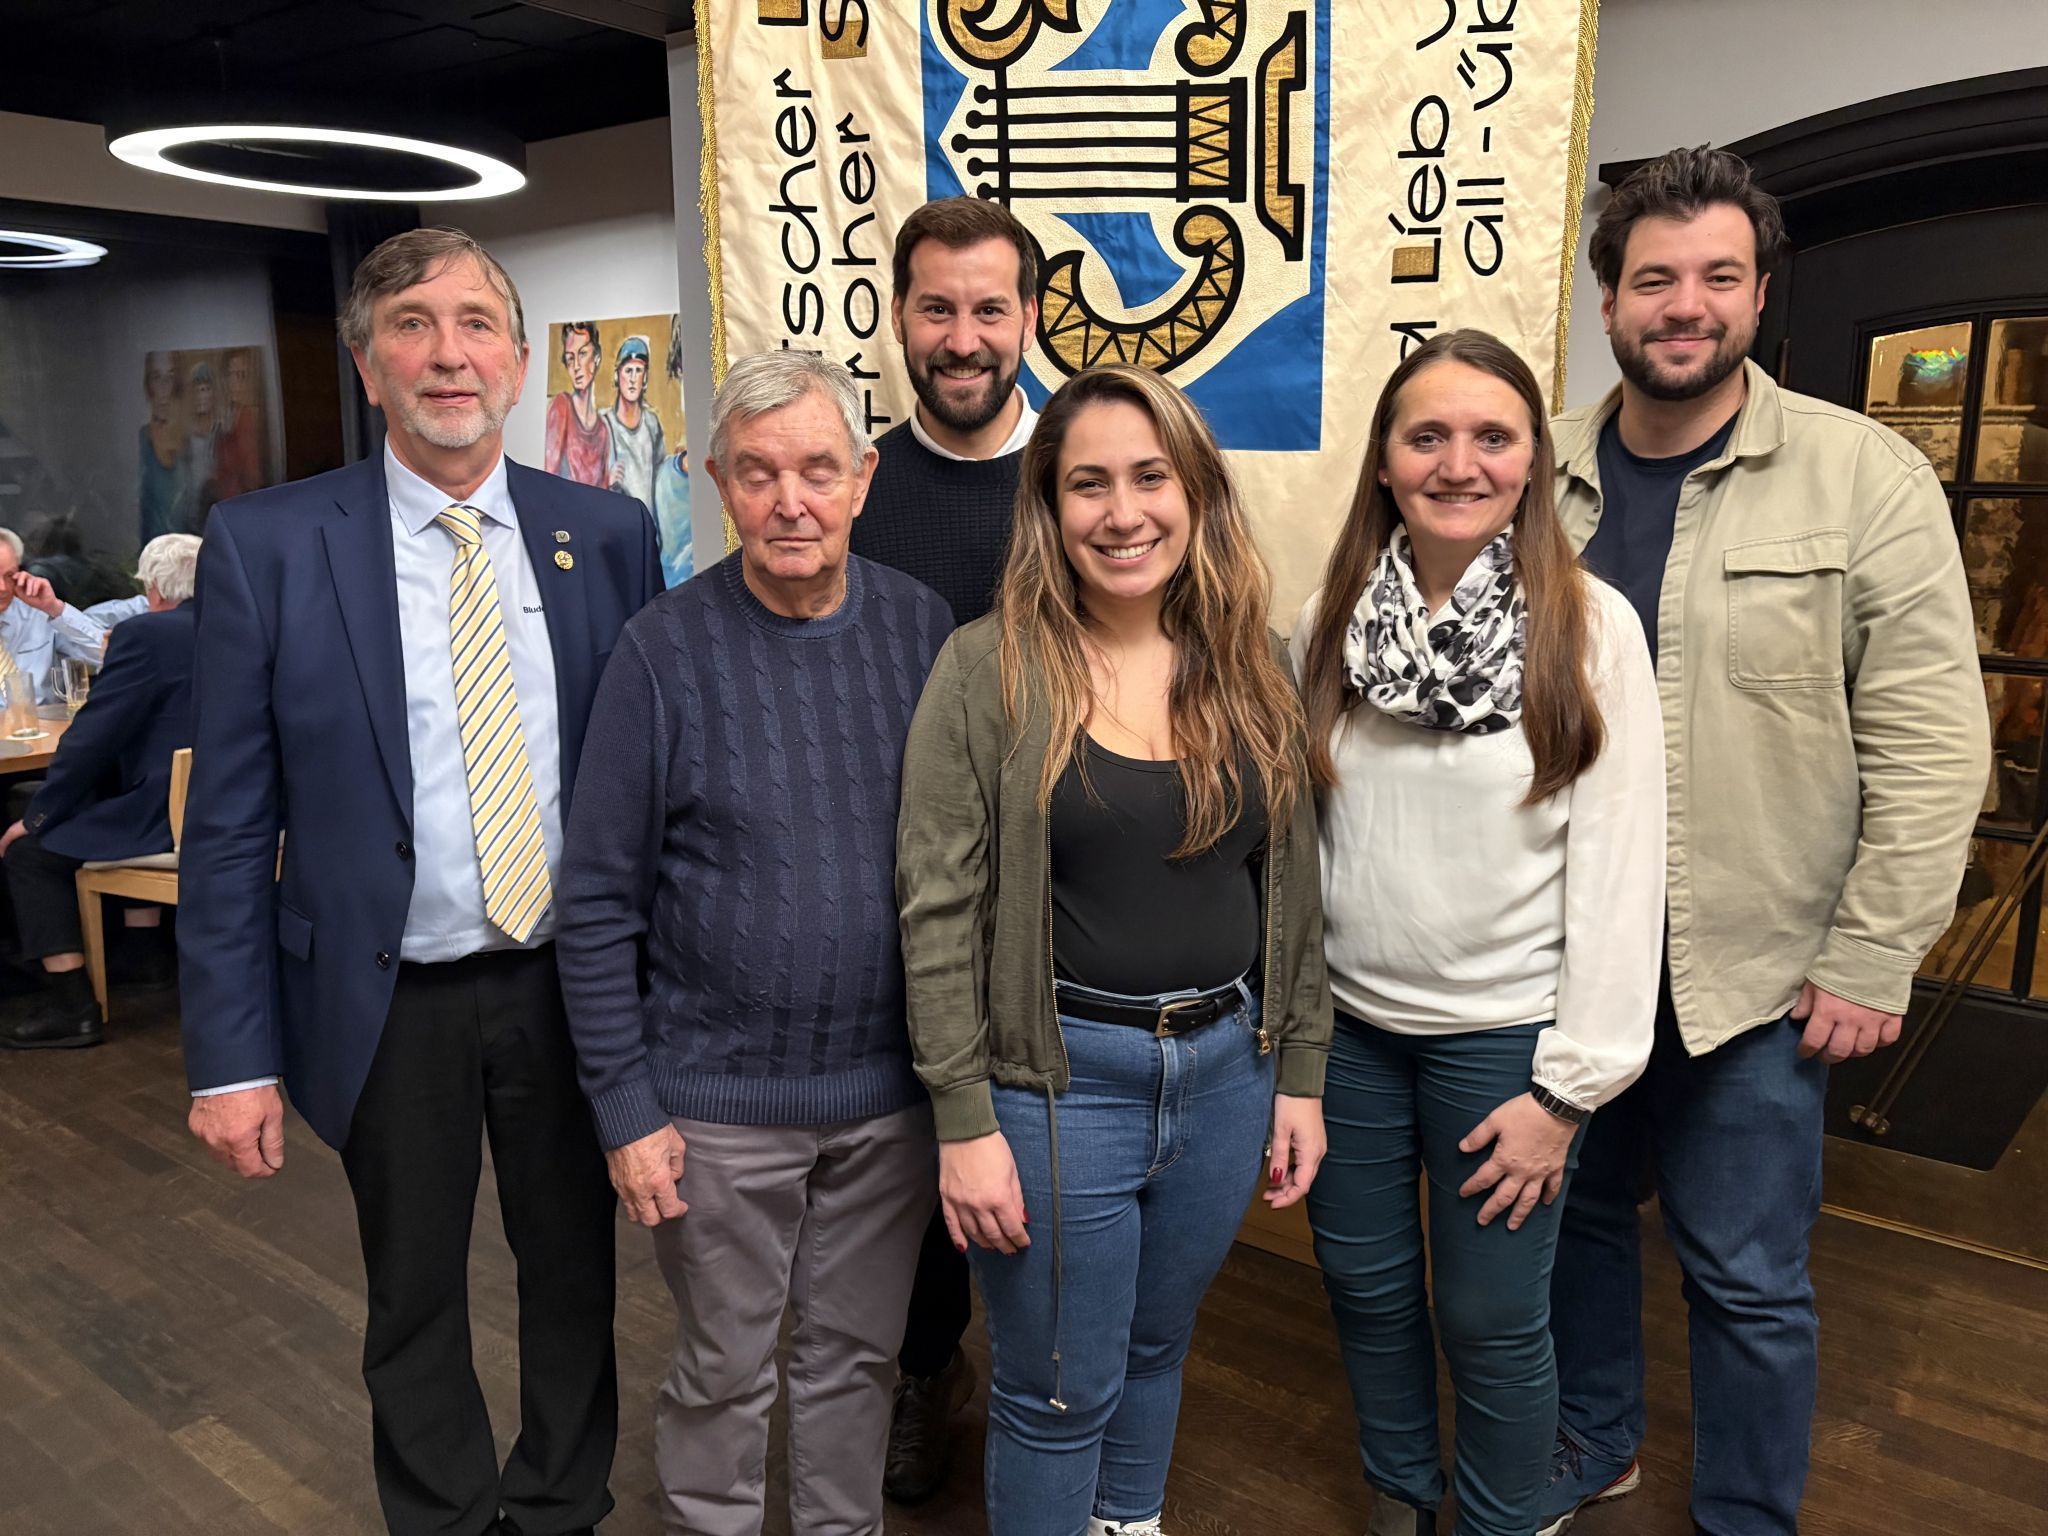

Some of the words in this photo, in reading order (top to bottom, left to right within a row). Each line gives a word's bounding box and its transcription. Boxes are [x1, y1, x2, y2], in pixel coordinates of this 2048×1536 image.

[758, 0, 809, 26] L
[819, 0, 869, 48] S
[1388, 94, 1450, 284] Lieb
